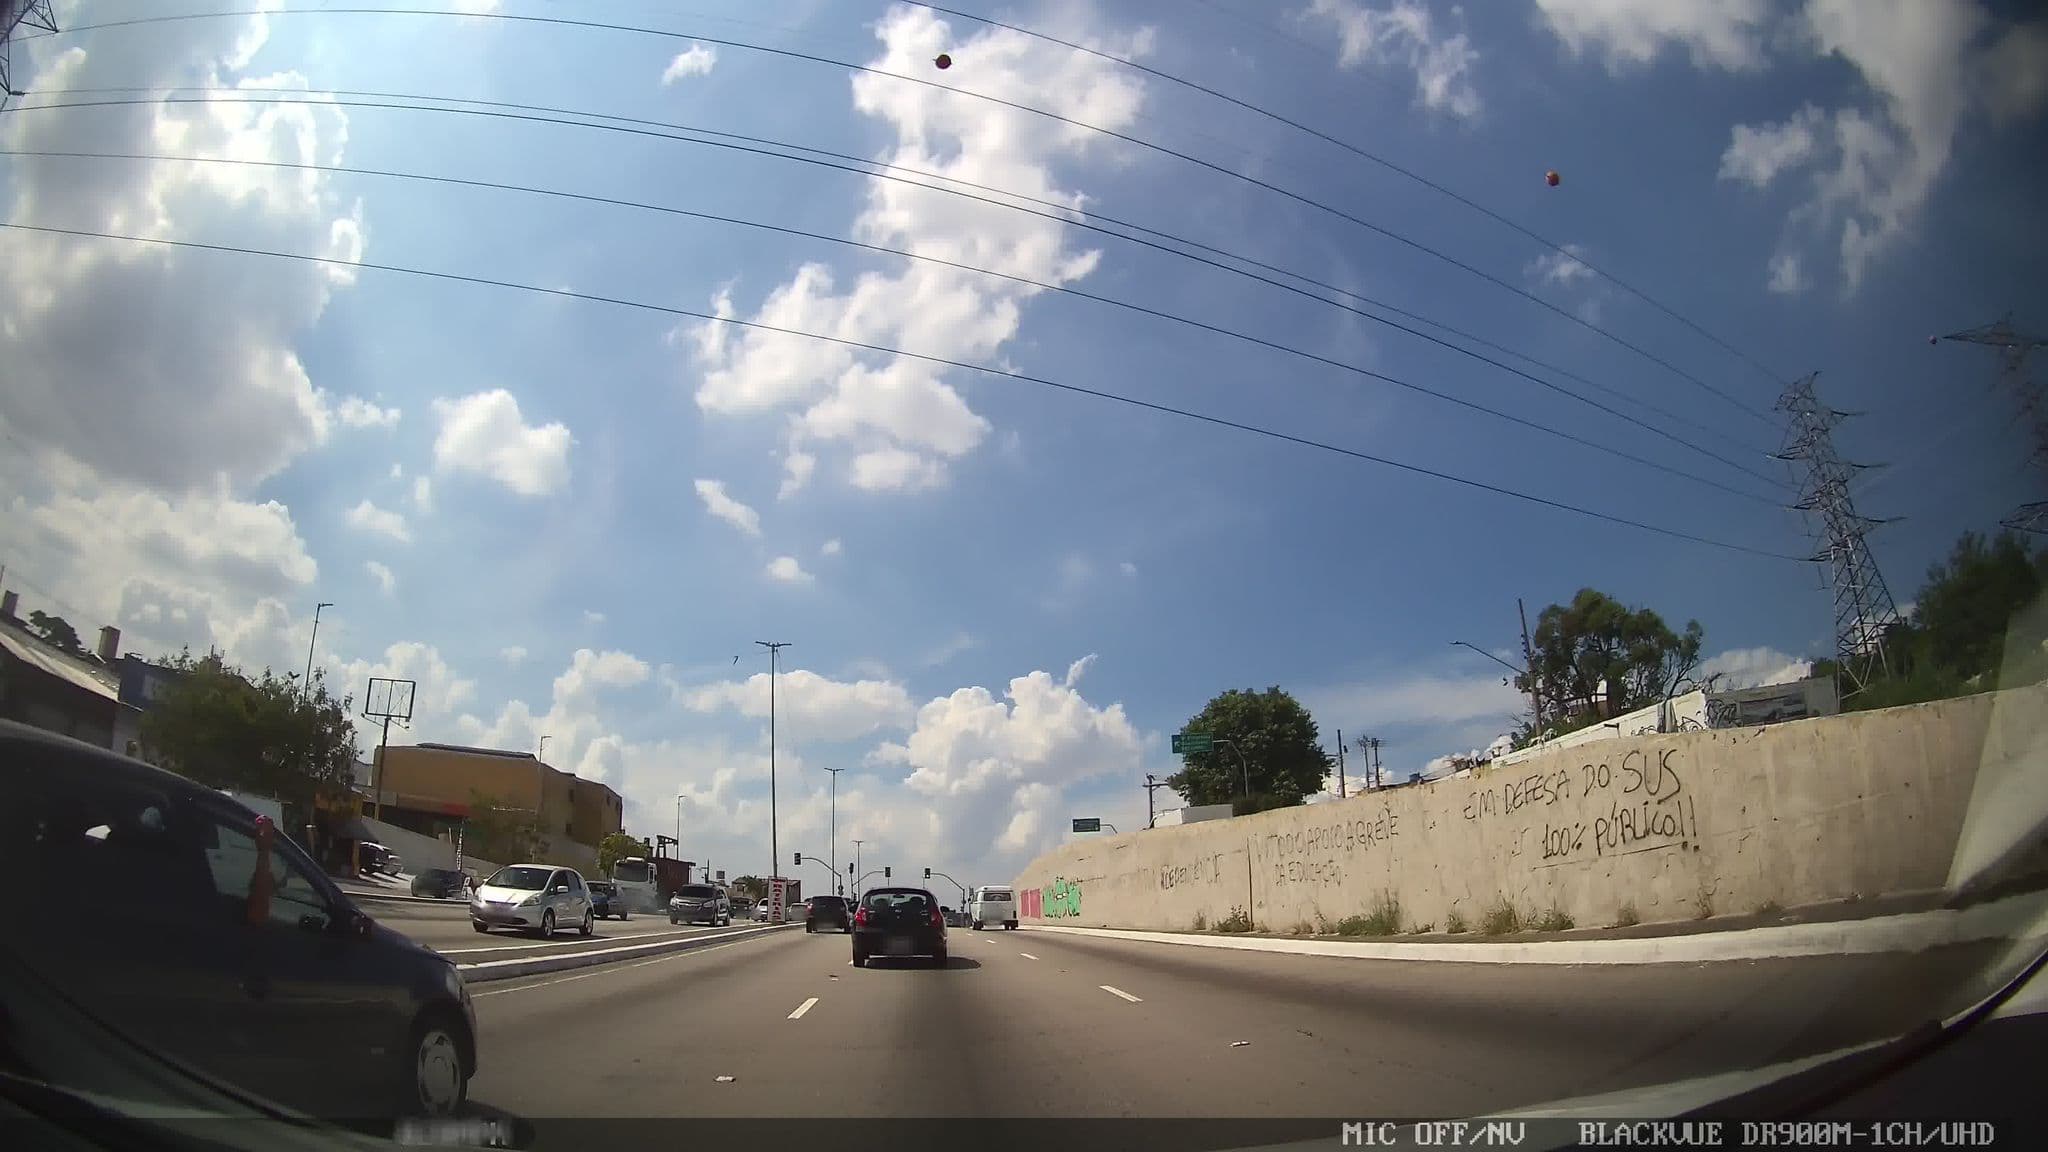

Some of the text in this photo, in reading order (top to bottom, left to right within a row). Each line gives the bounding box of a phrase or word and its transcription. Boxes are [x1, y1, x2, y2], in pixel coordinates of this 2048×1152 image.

[1463, 748, 1681, 821] EM DEFESA DO SUS
[1542, 822, 1586, 860] 100%
